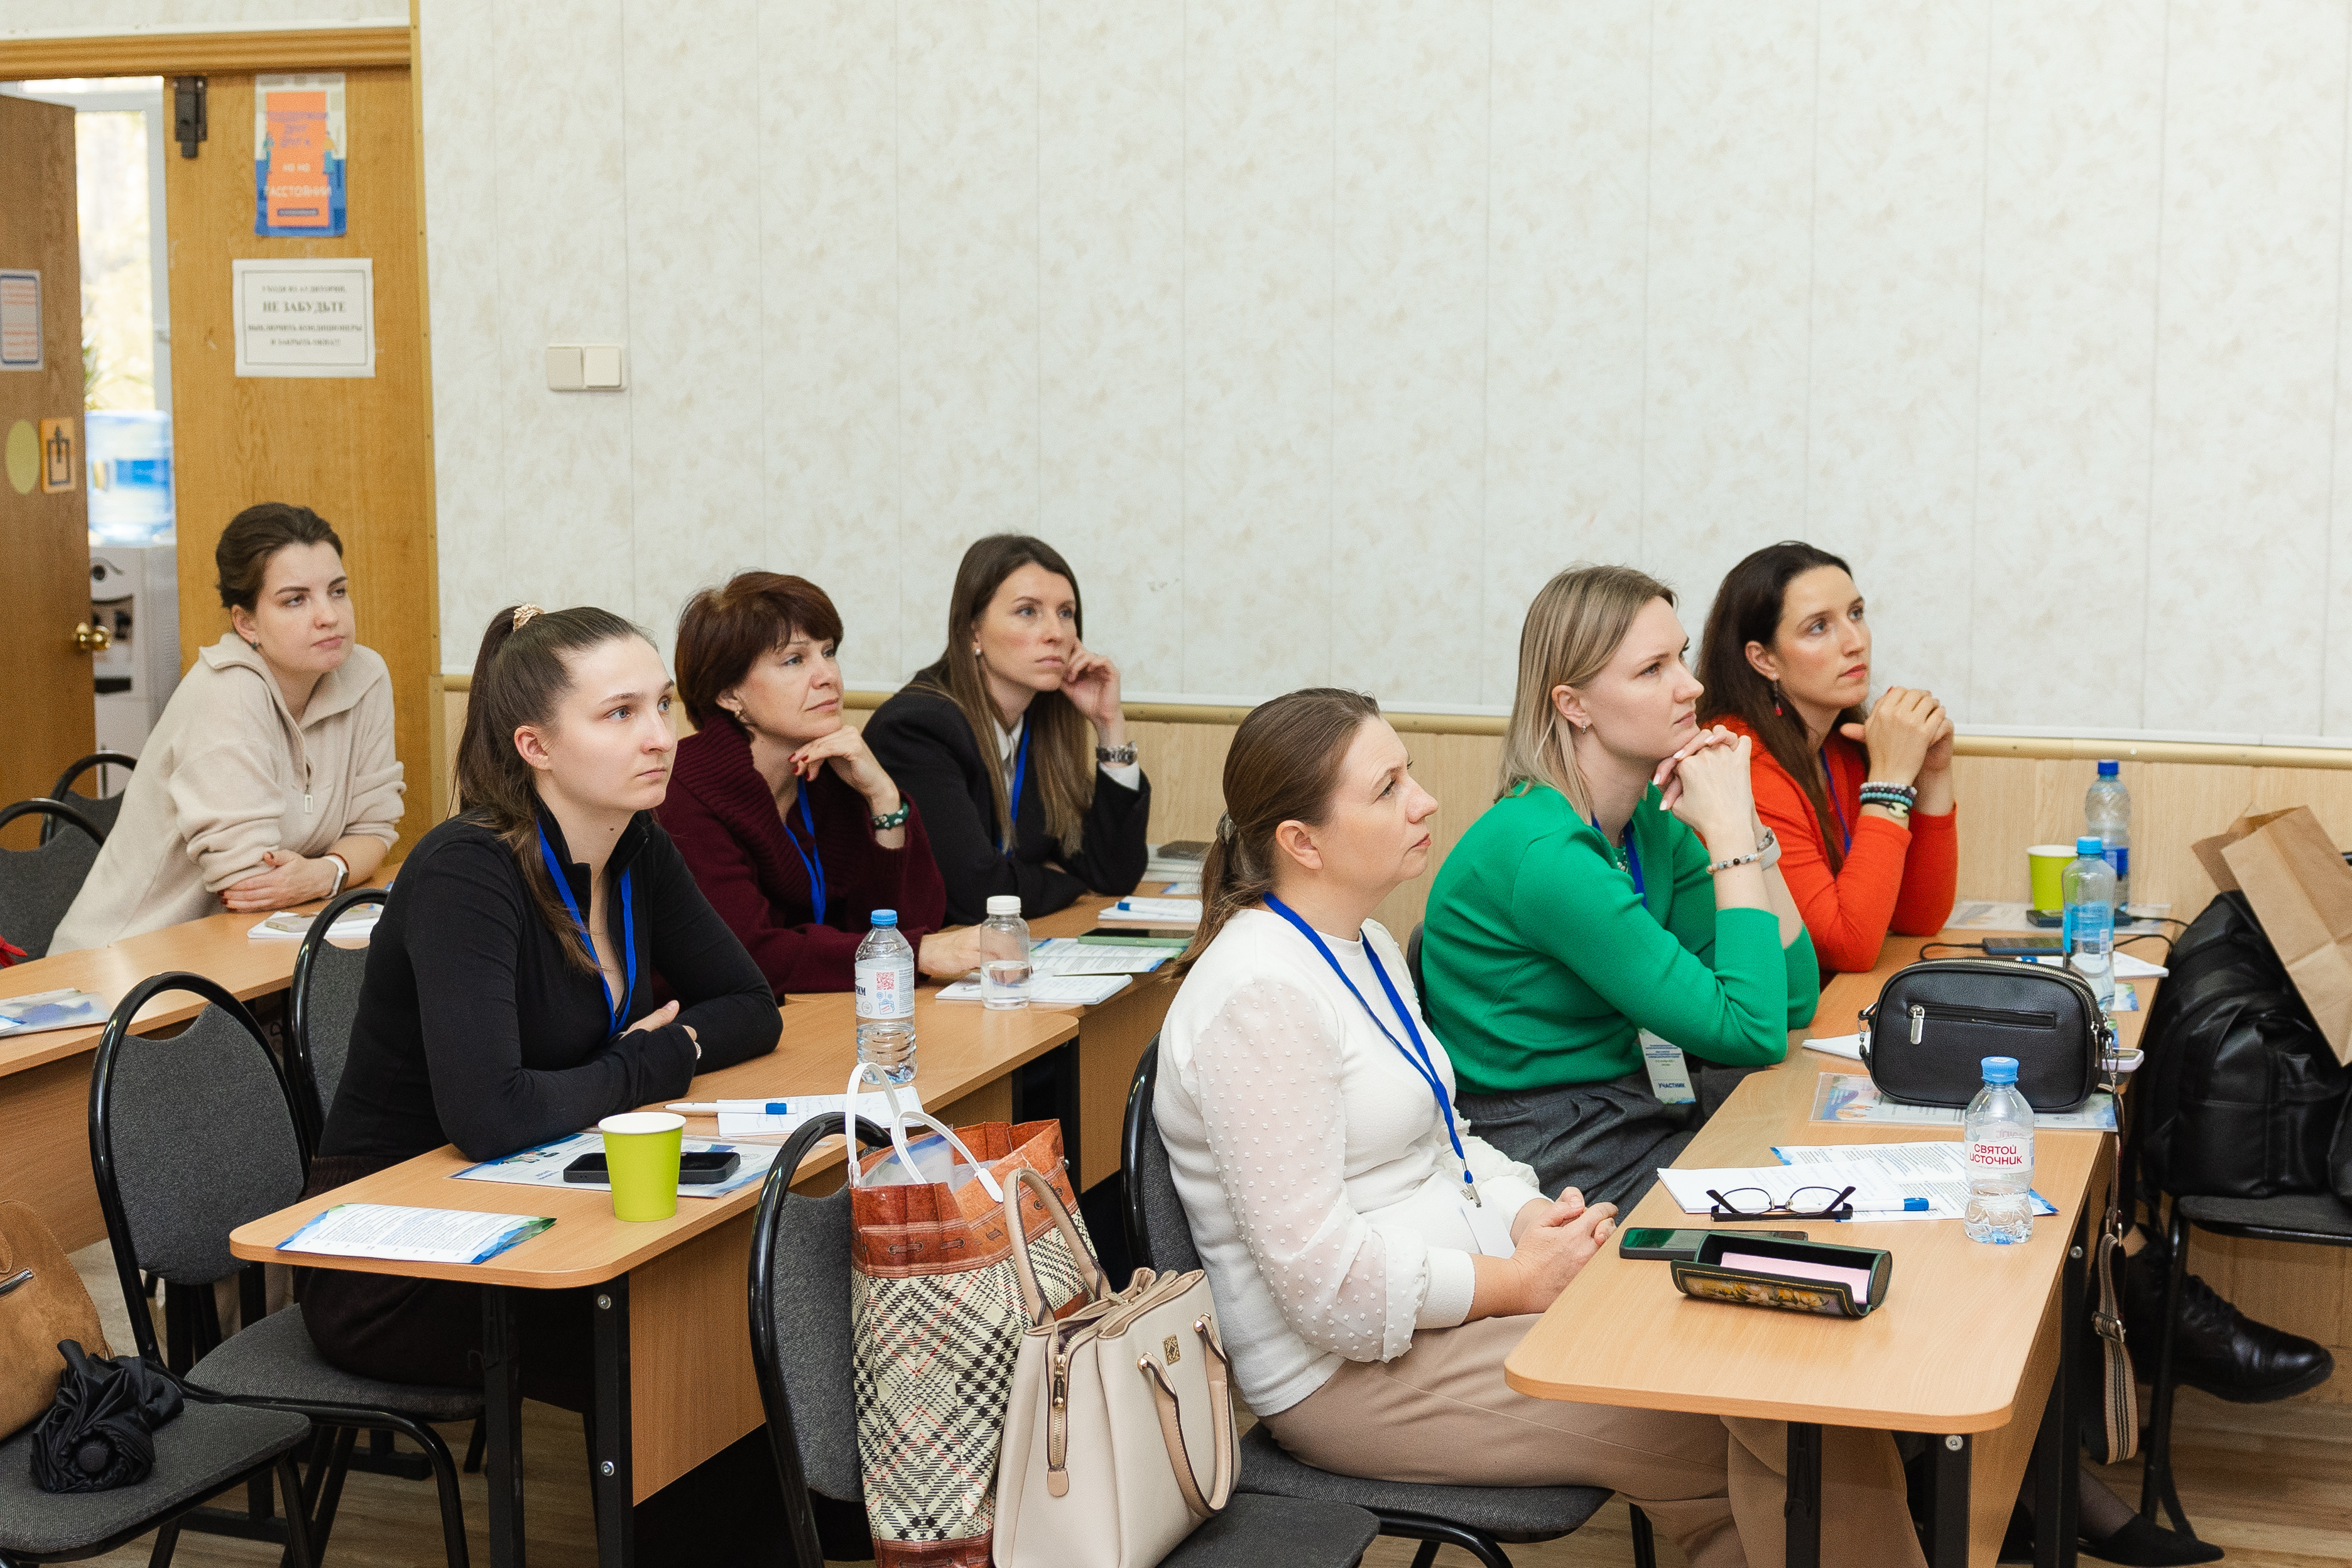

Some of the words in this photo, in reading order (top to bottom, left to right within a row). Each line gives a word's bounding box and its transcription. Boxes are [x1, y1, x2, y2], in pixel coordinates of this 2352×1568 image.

[263, 301, 279, 312] НЕ
[283, 301, 346, 314] ЗАБУДЬТЕ
[1974, 1143, 2017, 1154] СВЯТОЙ
[1969, 1152, 2022, 1165] ИСТОЧНИК
